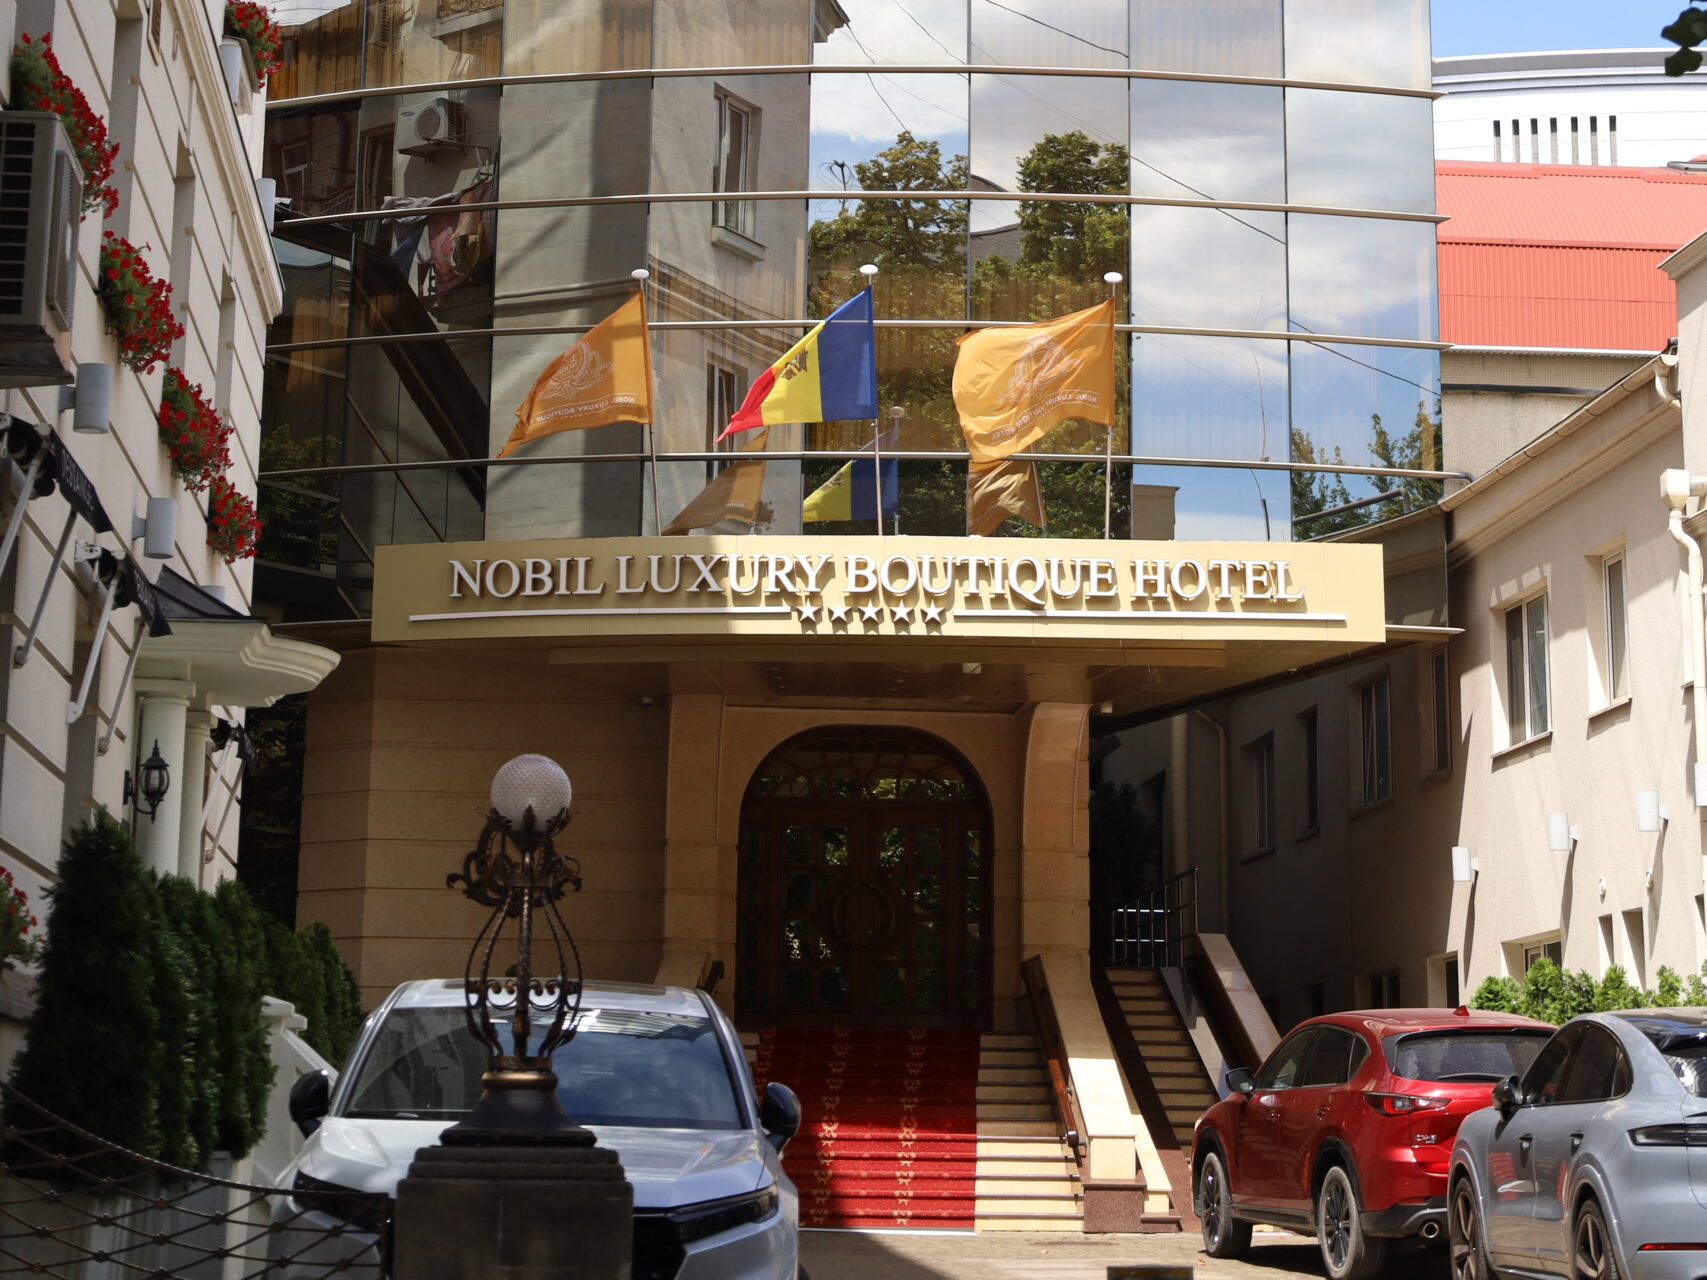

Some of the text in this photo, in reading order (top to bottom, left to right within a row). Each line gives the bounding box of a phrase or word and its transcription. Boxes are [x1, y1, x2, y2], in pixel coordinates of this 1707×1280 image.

[449, 553, 1306, 605] NOBIL LUXURY BOUTIQUE HOTEL
